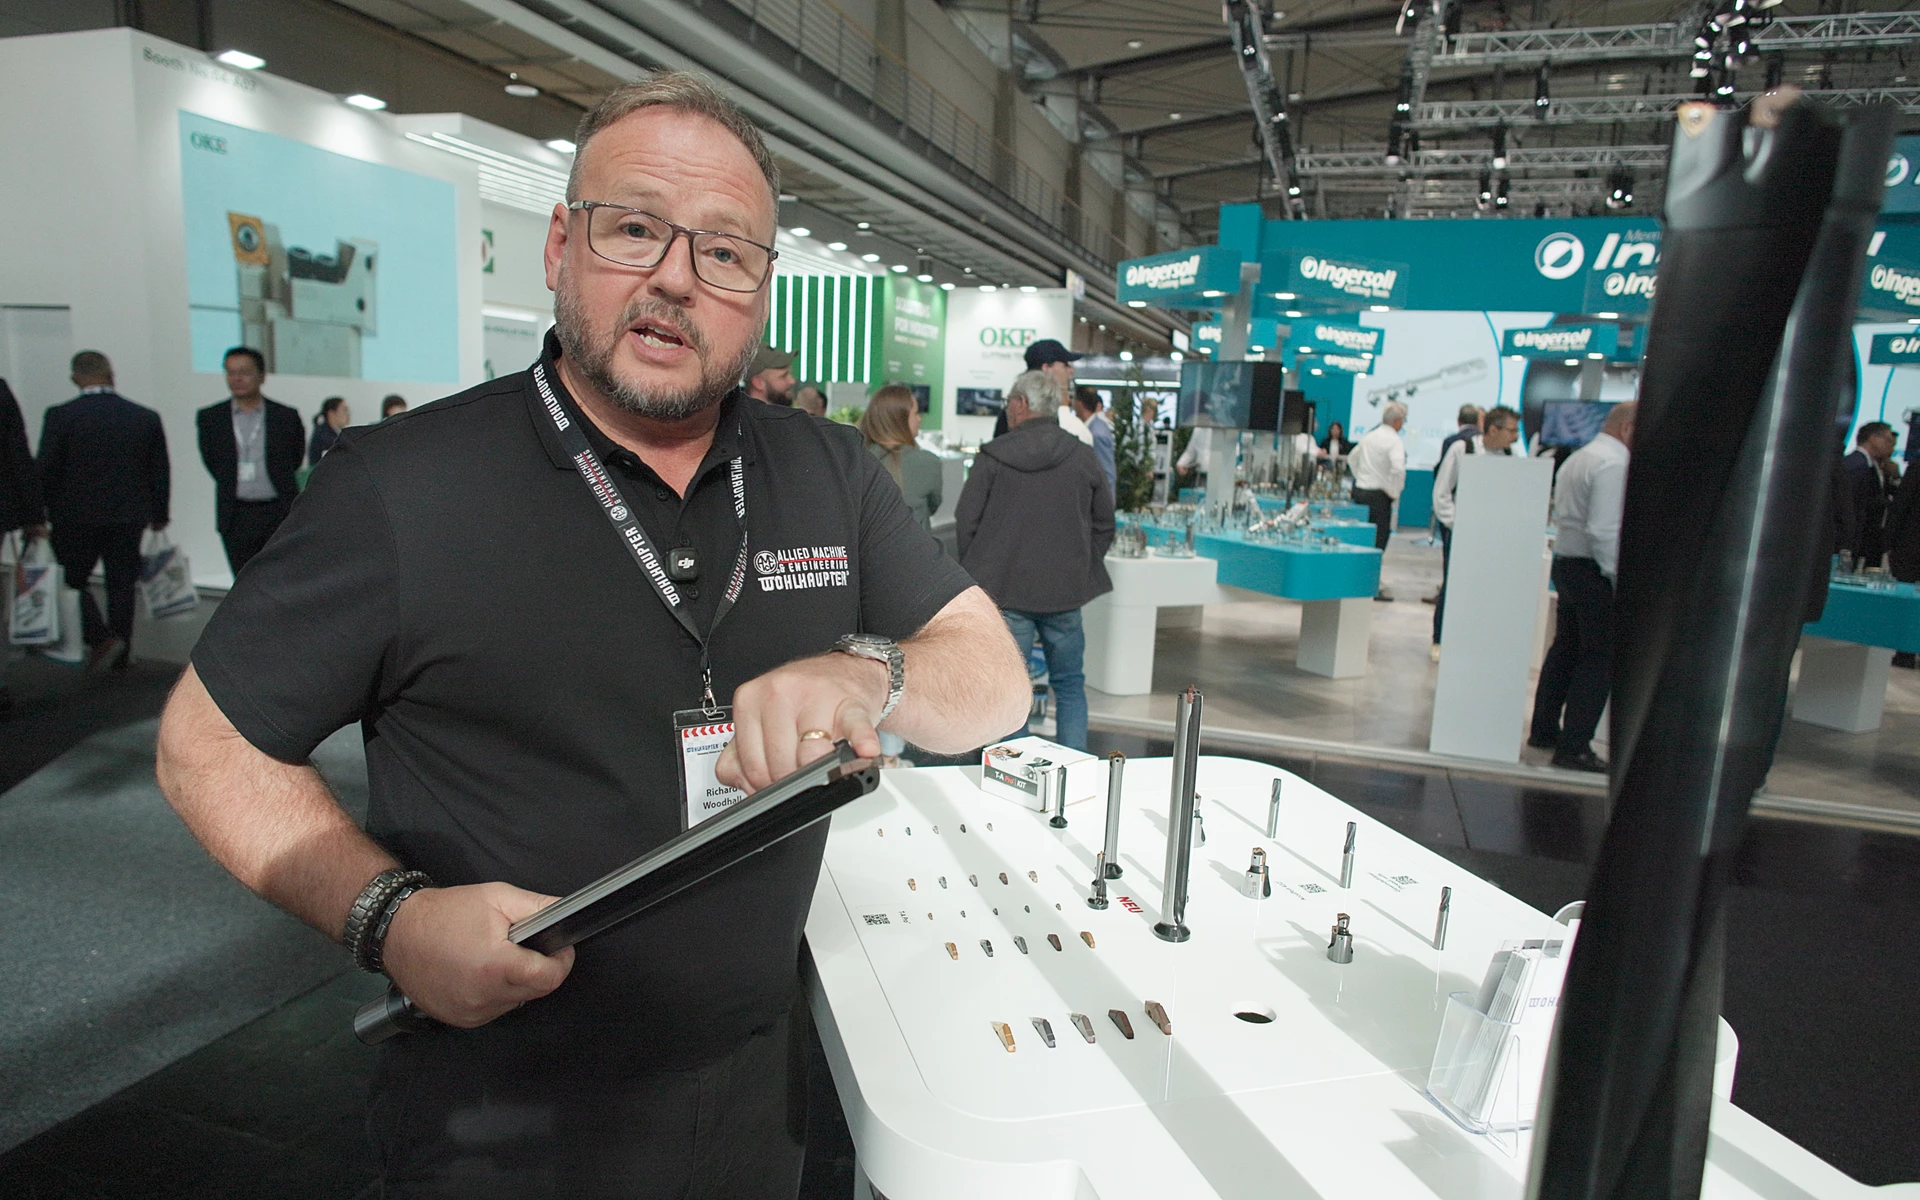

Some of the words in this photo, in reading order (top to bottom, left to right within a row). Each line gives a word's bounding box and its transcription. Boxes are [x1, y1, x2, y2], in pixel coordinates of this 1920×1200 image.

[190, 131, 228, 155] OKE
[1136, 254, 1200, 288] Ingersoll
[1315, 259, 1397, 290] Ingersoll
[979, 327, 1037, 347] OKE
[1328, 325, 1379, 346] Ingersoll
[1524, 328, 1592, 351] Ingersoll
[533, 363, 570, 432] WOHLHAUPTER
[574, 452, 598, 485] MACHINE
[583, 449, 617, 499] ENGINEERING
[593, 483, 614, 508] ALLIED
[730, 456, 745, 518] OHLHAUPTER
[777, 547, 810, 561] ALLIED
[811, 545, 848, 558] MACHINE
[625, 526, 680, 606] WOHLHAUPTER
[788, 559, 848, 573] ENGINEERING
[757, 570, 848, 592] WOHLHAUPTER
[706, 786, 738, 797] Richard
[1016, 780, 1027, 789] KIT
[1116, 896, 1144, 913] NEU
